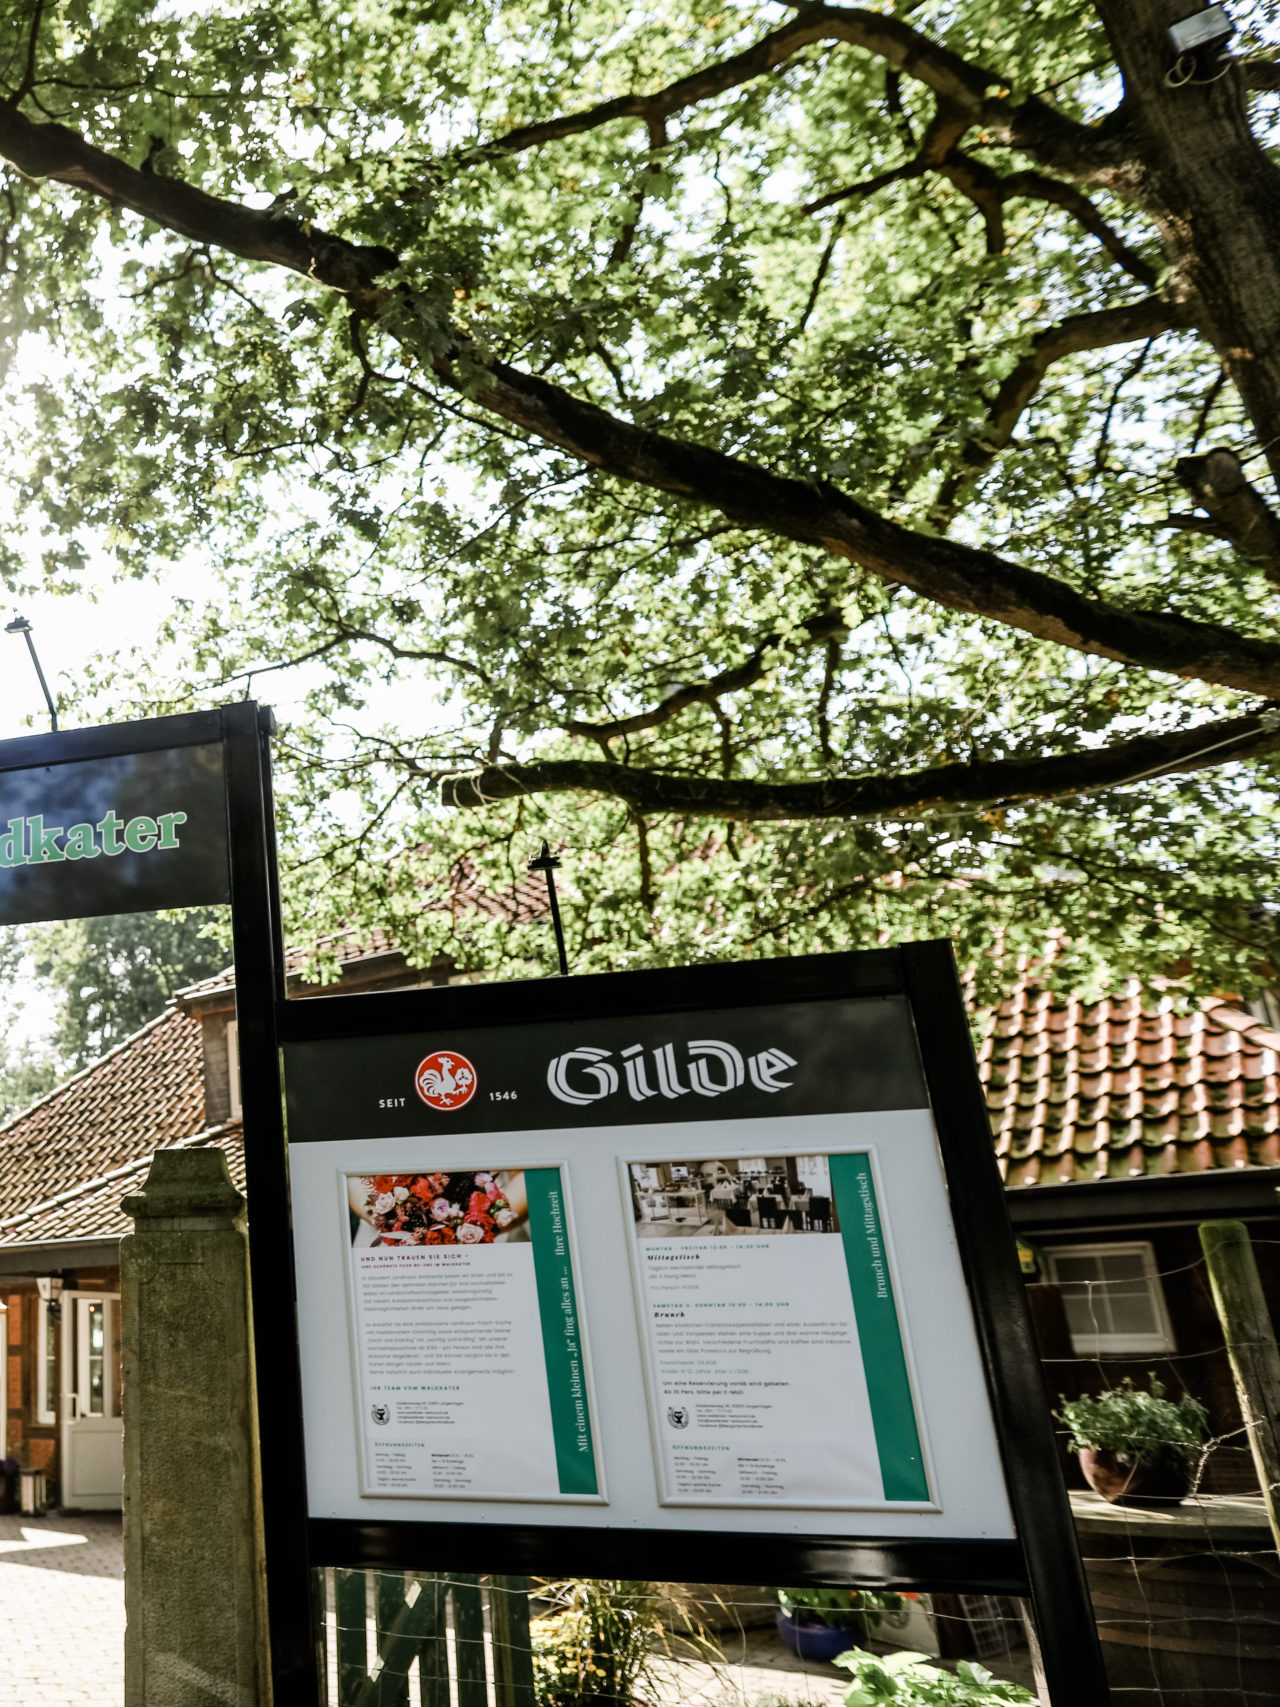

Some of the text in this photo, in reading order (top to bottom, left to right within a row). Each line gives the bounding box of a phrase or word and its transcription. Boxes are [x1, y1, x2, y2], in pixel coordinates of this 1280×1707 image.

[547, 1039, 798, 1105] Gilde
[379, 1091, 518, 1108] SEIT 1546
[547, 1191, 566, 1256] Ihre Hochzeit
[856, 1172, 888, 1298] Brunch und Mittagstisch
[647, 1253, 701, 1262] Mittagstisch
[560, 1277, 569, 1290] an
[561, 1291, 573, 1315] alles
[564, 1316, 575, 1336] fing
[570, 1360, 583, 1398] kleinen
[576, 1400, 586, 1432] einem
[577, 1433, 589, 1453] Mit
